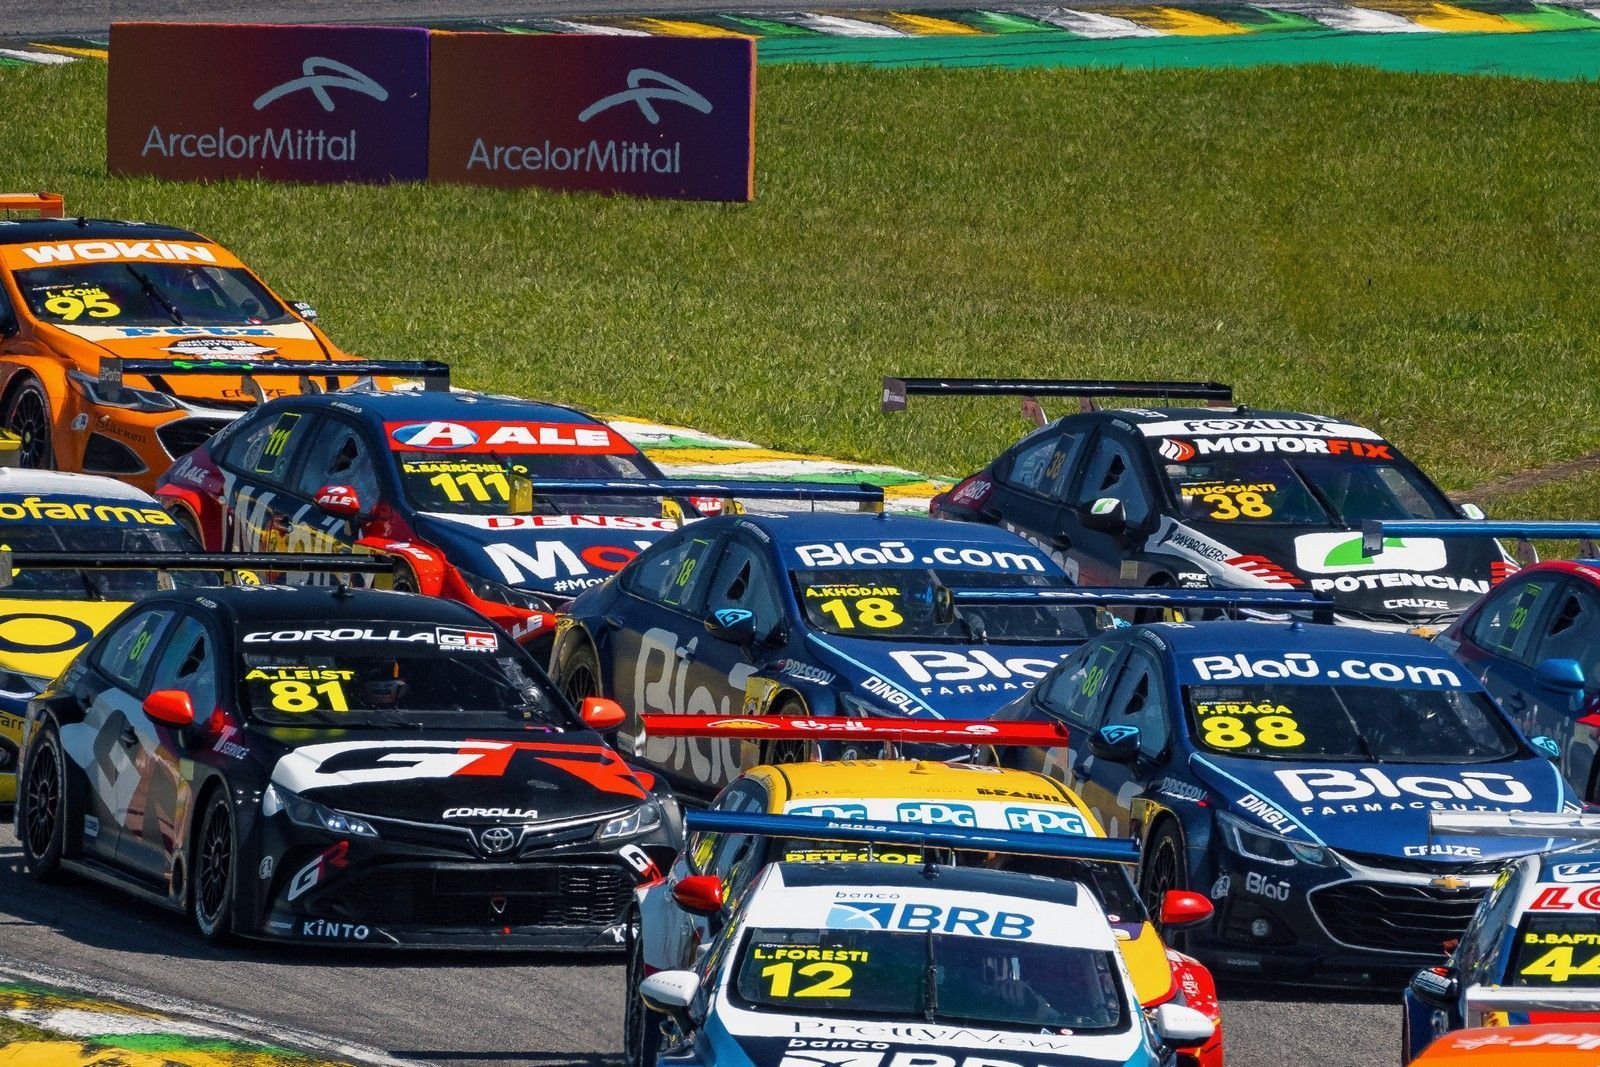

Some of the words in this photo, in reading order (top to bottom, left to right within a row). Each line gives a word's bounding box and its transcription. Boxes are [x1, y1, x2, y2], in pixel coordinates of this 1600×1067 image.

[141, 126, 356, 161] ArcelorMittal
[467, 139, 681, 174] ArcelorMittal
[45, 293, 120, 320] 95
[222, 388, 288, 398] CZE
[485, 426, 611, 447] ALE
[1195, 437, 1393, 460] MOTORFIX
[403, 463, 527, 474] R.BARRICHELO
[431, 473, 510, 502] 111
[1181, 482, 1277, 497] MUGGIATI
[318, 496, 352, 506] ALE
[1203, 492, 1273, 520] 38
[1173, 534, 1228, 562] PAYBROKERS
[483, 540, 652, 585] Mo
[676, 558, 697, 587] 18
[806, 586, 901, 598] A.KHODAIR
[1383, 598, 1450, 610] CRUZE
[821, 598, 904, 629] 18
[243, 628, 436, 644] COROLLA
[440, 634, 496, 648] GR
[506, 614, 544, 640] LE
[245, 669, 355, 681] A.LEIST
[889, 650, 1069, 683] Bla
[270, 680, 349, 713] 81
[861, 675, 924, 715] DINGLI
[1197, 704, 1293, 716] F.FRAGA
[1202, 716, 1306, 749] 88
[442, 807, 538, 819] COROLLA
[792, 806, 865, 820] PG
[900, 804, 974, 827] PPG
[1008, 810, 1085, 835] PPG
[1236, 793, 1298, 835] DINGLI
[836, 891, 900, 900] banco
[897, 903, 1035, 939] BRB
[754, 949, 869, 962] L.FORESTI
[762, 962, 853, 998] 12
[788, 1038, 890, 1049] banco
